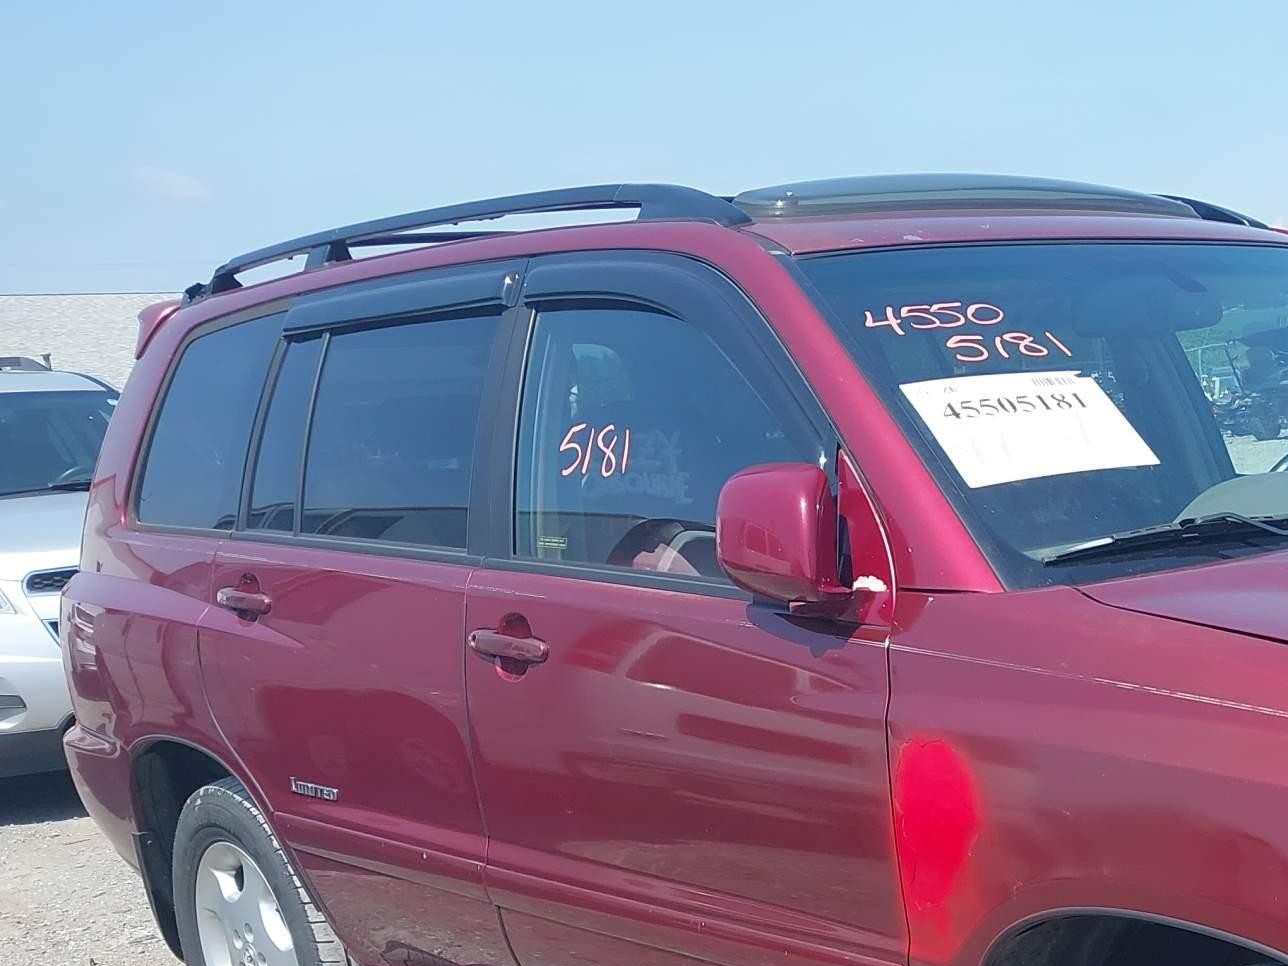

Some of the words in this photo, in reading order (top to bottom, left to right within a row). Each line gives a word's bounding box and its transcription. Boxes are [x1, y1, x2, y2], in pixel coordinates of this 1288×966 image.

[864, 301, 1004, 336] 4550
[946, 331, 1073, 362] 5181
[943, 391, 1088, 420] 45505181
[559, 423, 630, 478] 5181
